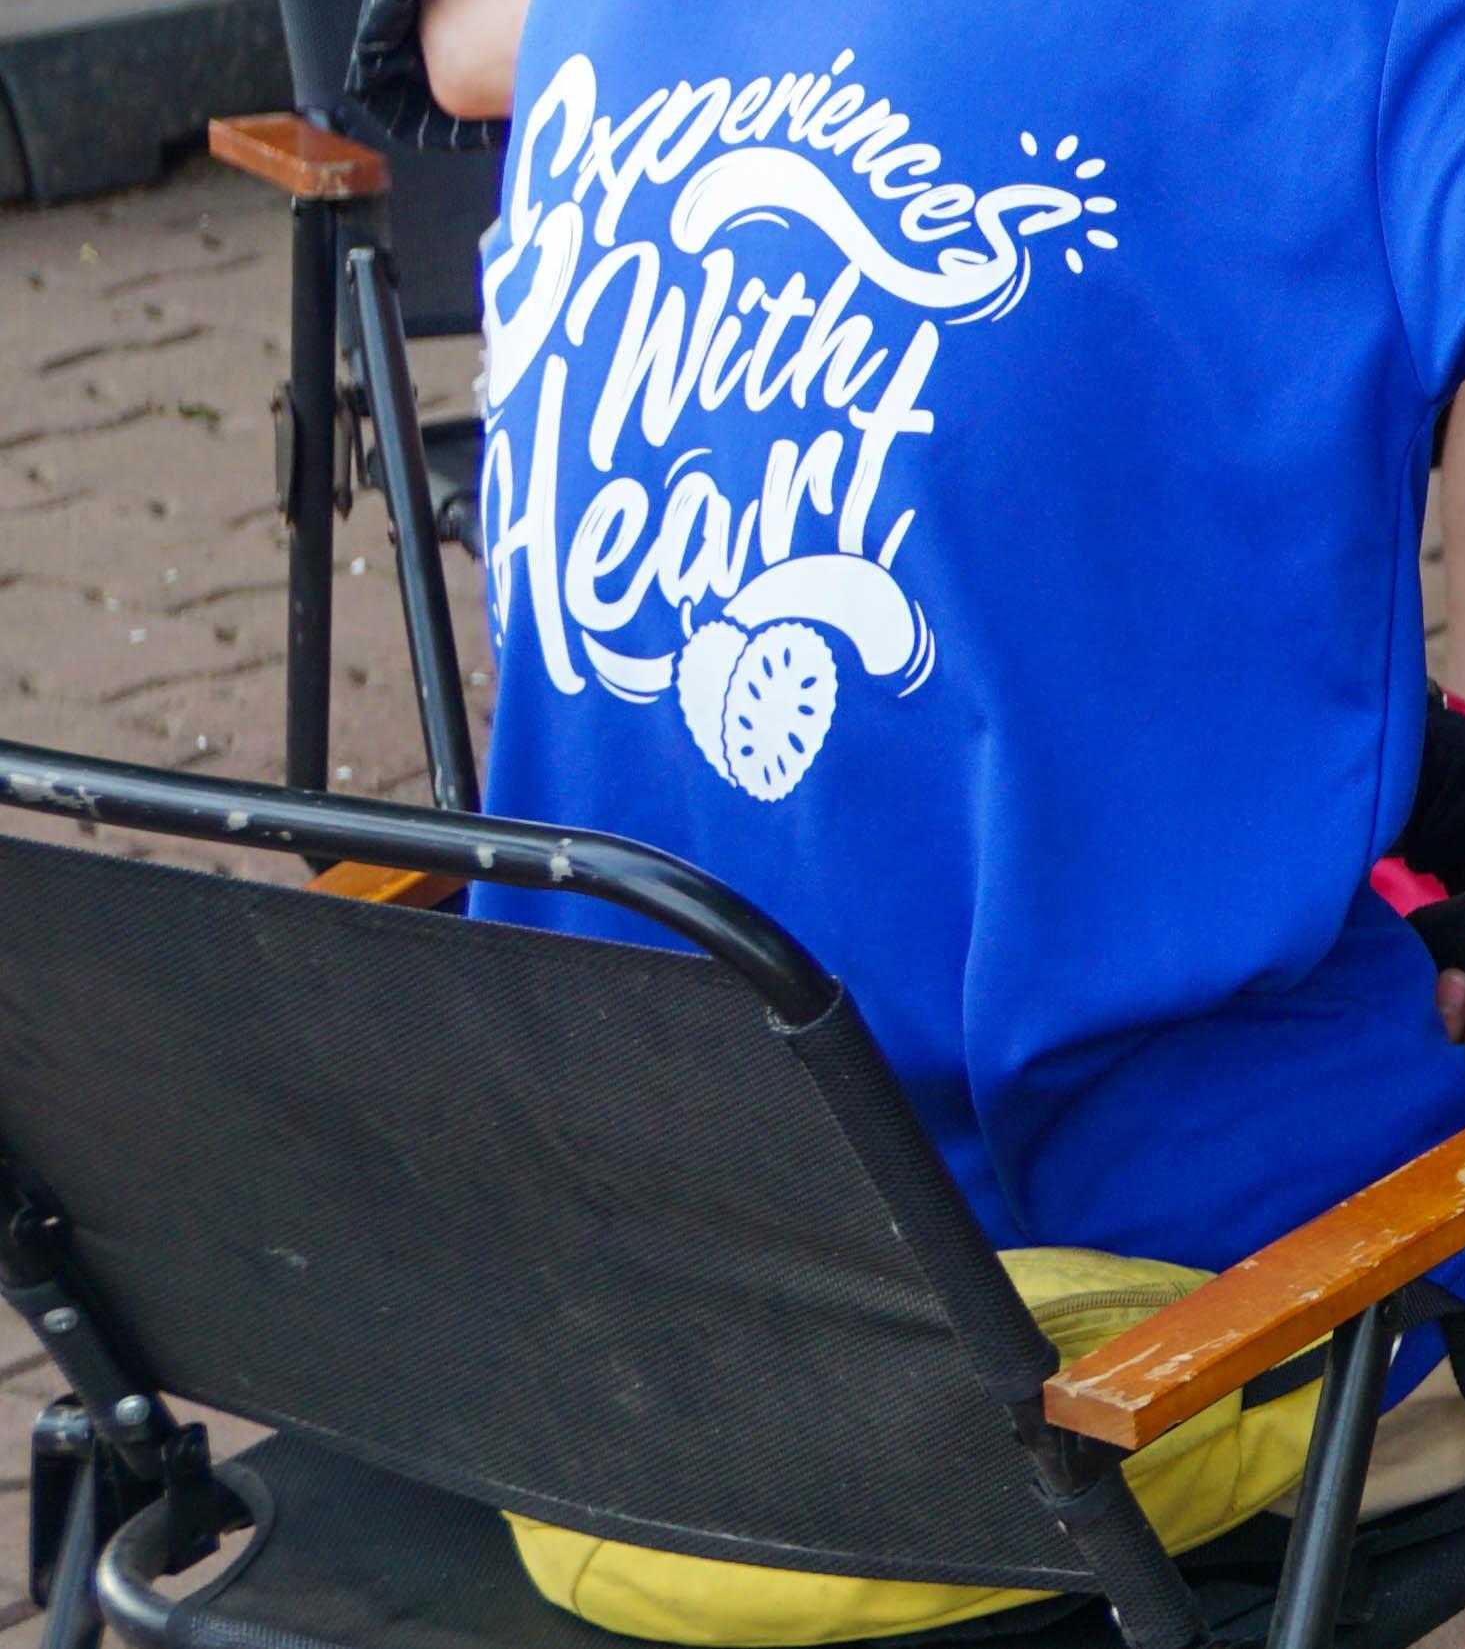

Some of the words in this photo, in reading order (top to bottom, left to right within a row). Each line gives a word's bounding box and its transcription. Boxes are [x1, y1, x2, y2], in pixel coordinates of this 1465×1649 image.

[483, 48, 1081, 406] Experiences
[569, 241, 890, 472] With
[482, 320, 940, 695] Heart
